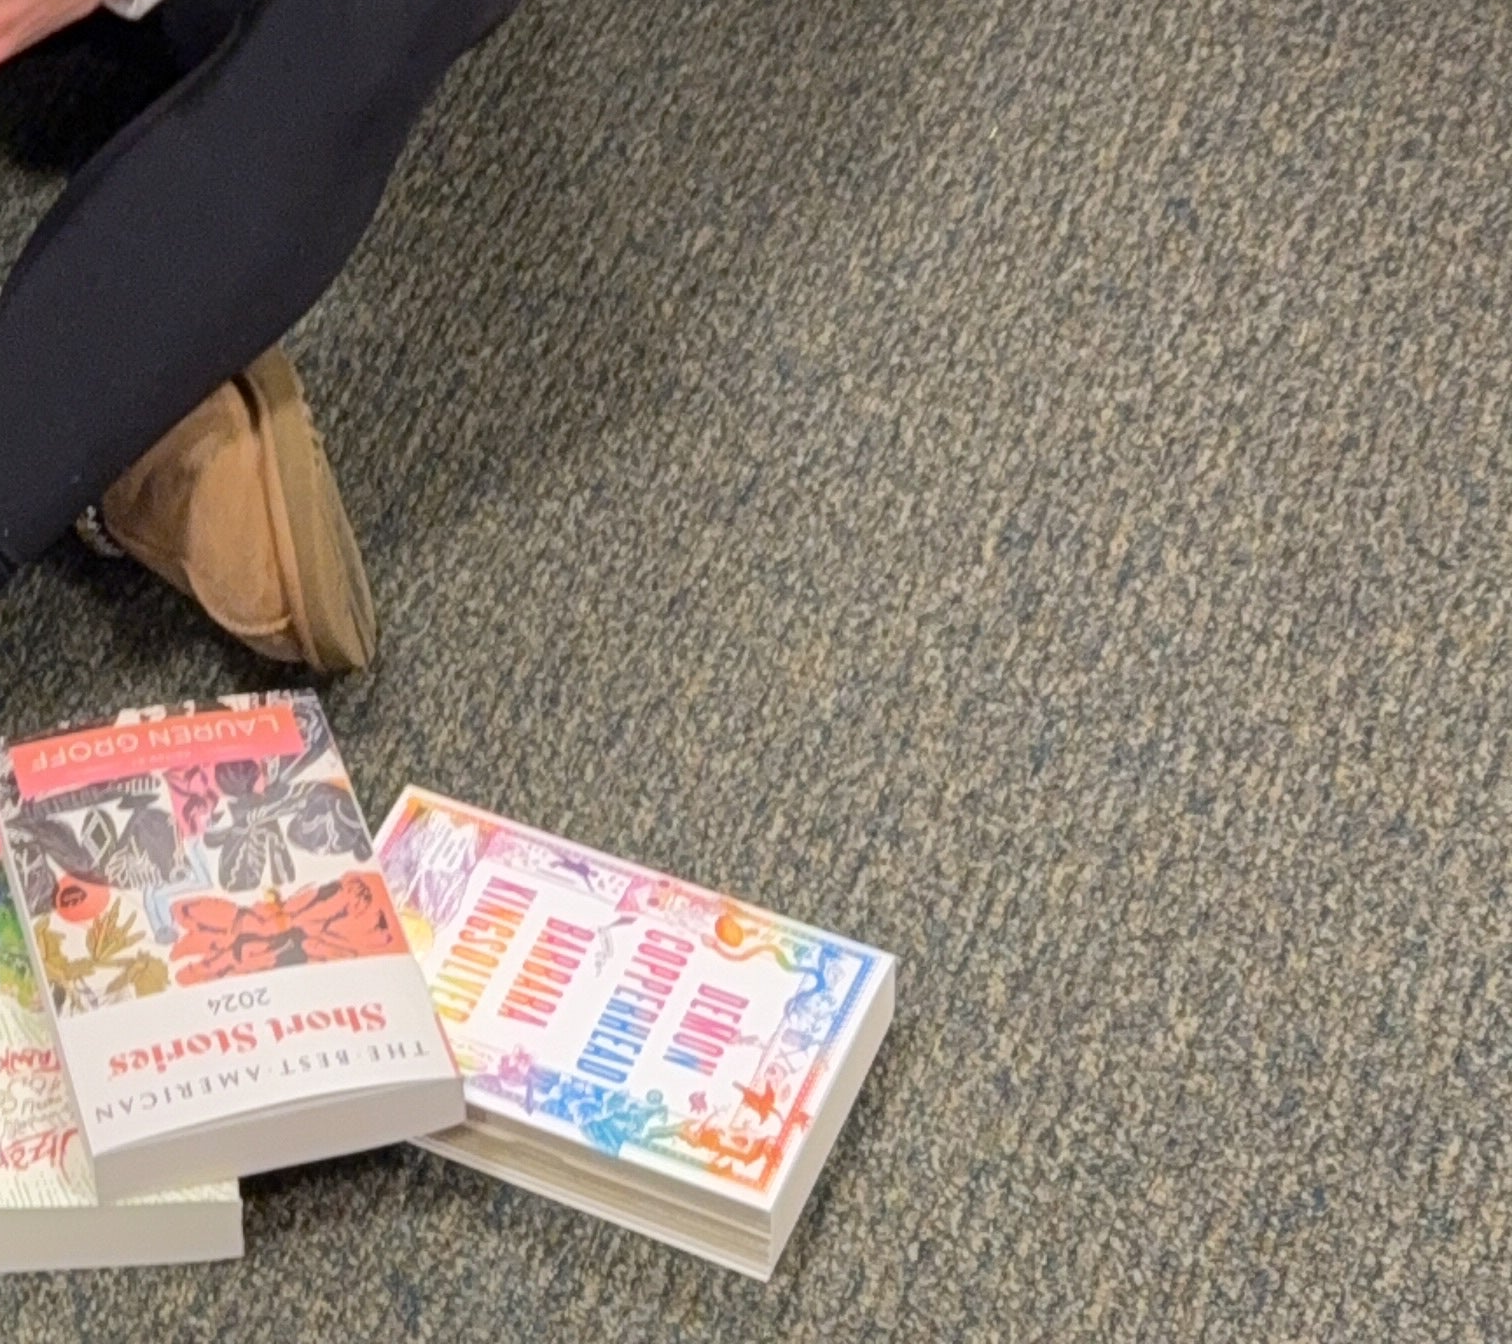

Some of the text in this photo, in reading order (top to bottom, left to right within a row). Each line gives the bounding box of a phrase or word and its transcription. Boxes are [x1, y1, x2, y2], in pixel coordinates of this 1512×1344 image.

[30, 713, 280, 774] LAUREN GROFF
[428, 875, 538, 1024] KINGSOLVER
[496, 916, 596, 1029] BARBARA
[207, 986, 272, 1014] 2024
[576, 928, 696, 1085] COPPERHEAD
[663, 983, 750, 1077] DEMON
[109, 1002, 387, 1077] Short Stories
[280, 1048, 353, 1079] BEST
[365, 1039, 430, 1062] THE
[95, 1065, 261, 1125] AMERICAN
